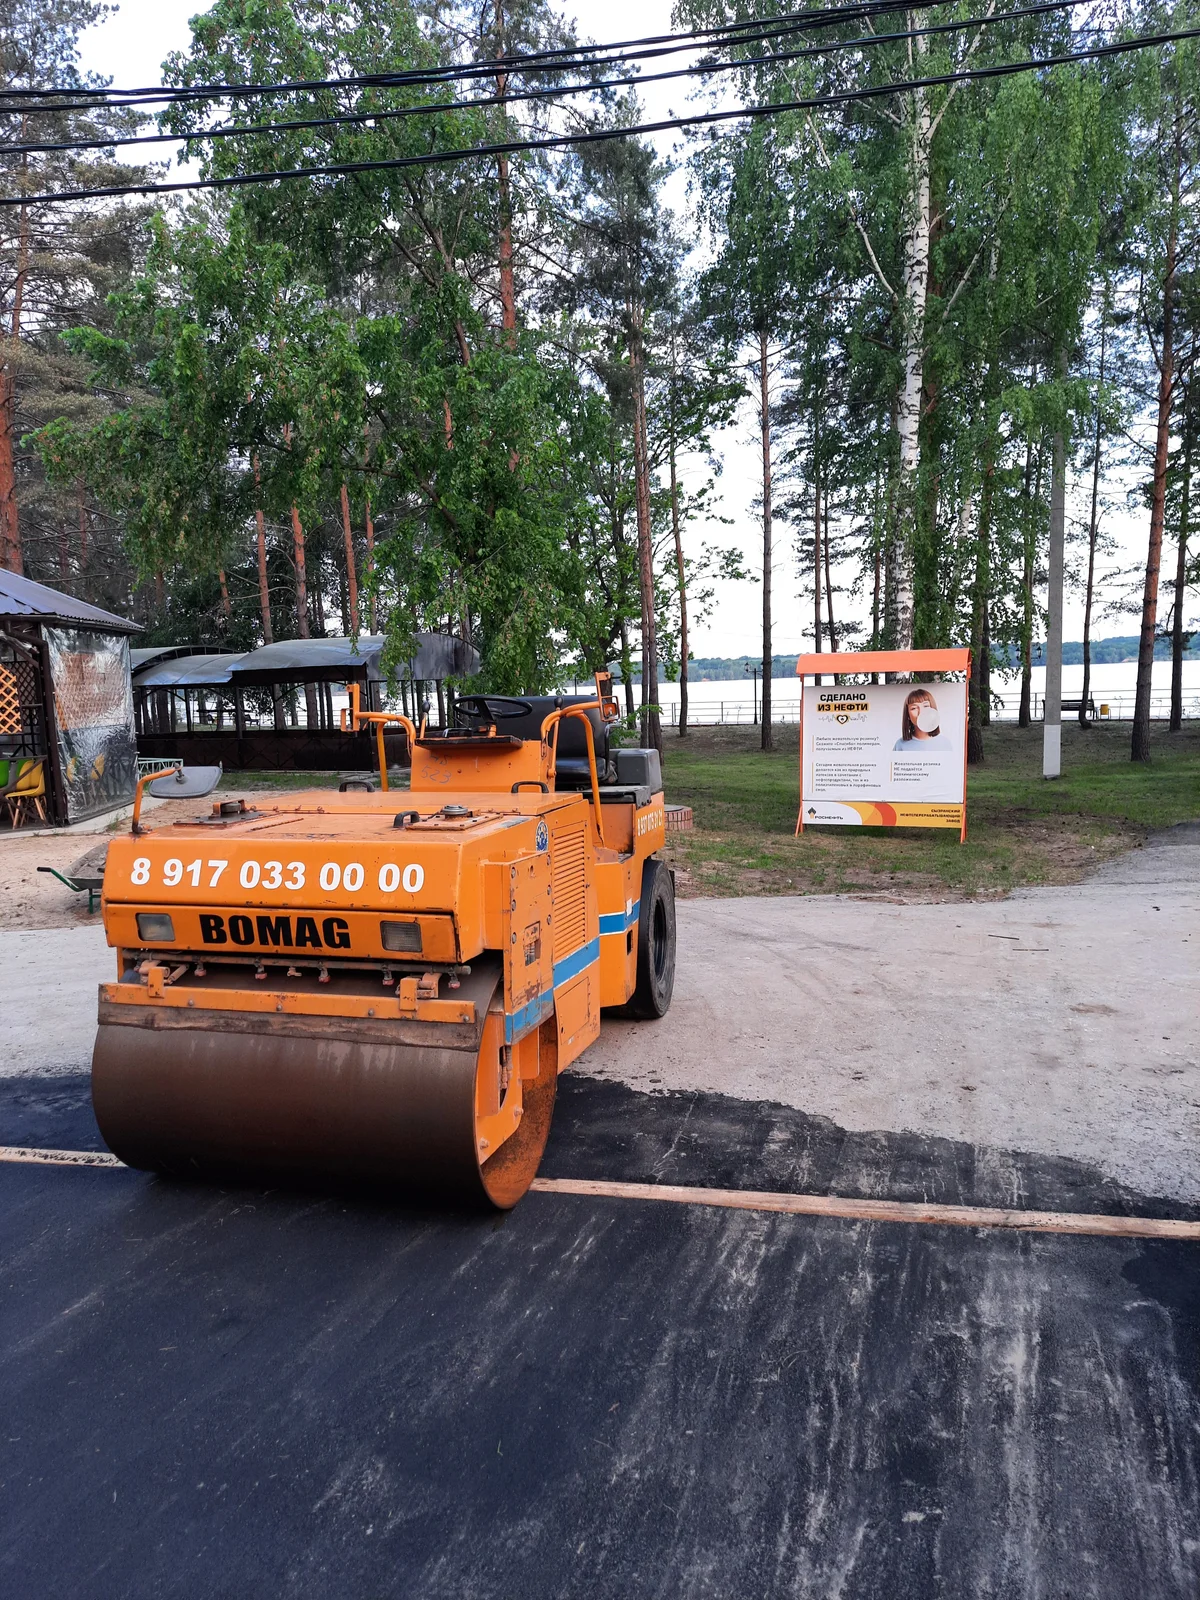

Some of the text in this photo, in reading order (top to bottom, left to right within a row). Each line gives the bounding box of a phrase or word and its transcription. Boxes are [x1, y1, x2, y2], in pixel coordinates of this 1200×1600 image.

[820, 693, 866, 702] СДЕЛАНО
[834, 703, 868, 711] НЕФТИ
[420, 762, 452, 784] 523
[130, 857, 425, 893] 8 917 033 00 00
[198, 914, 351, 949] BOMAG
